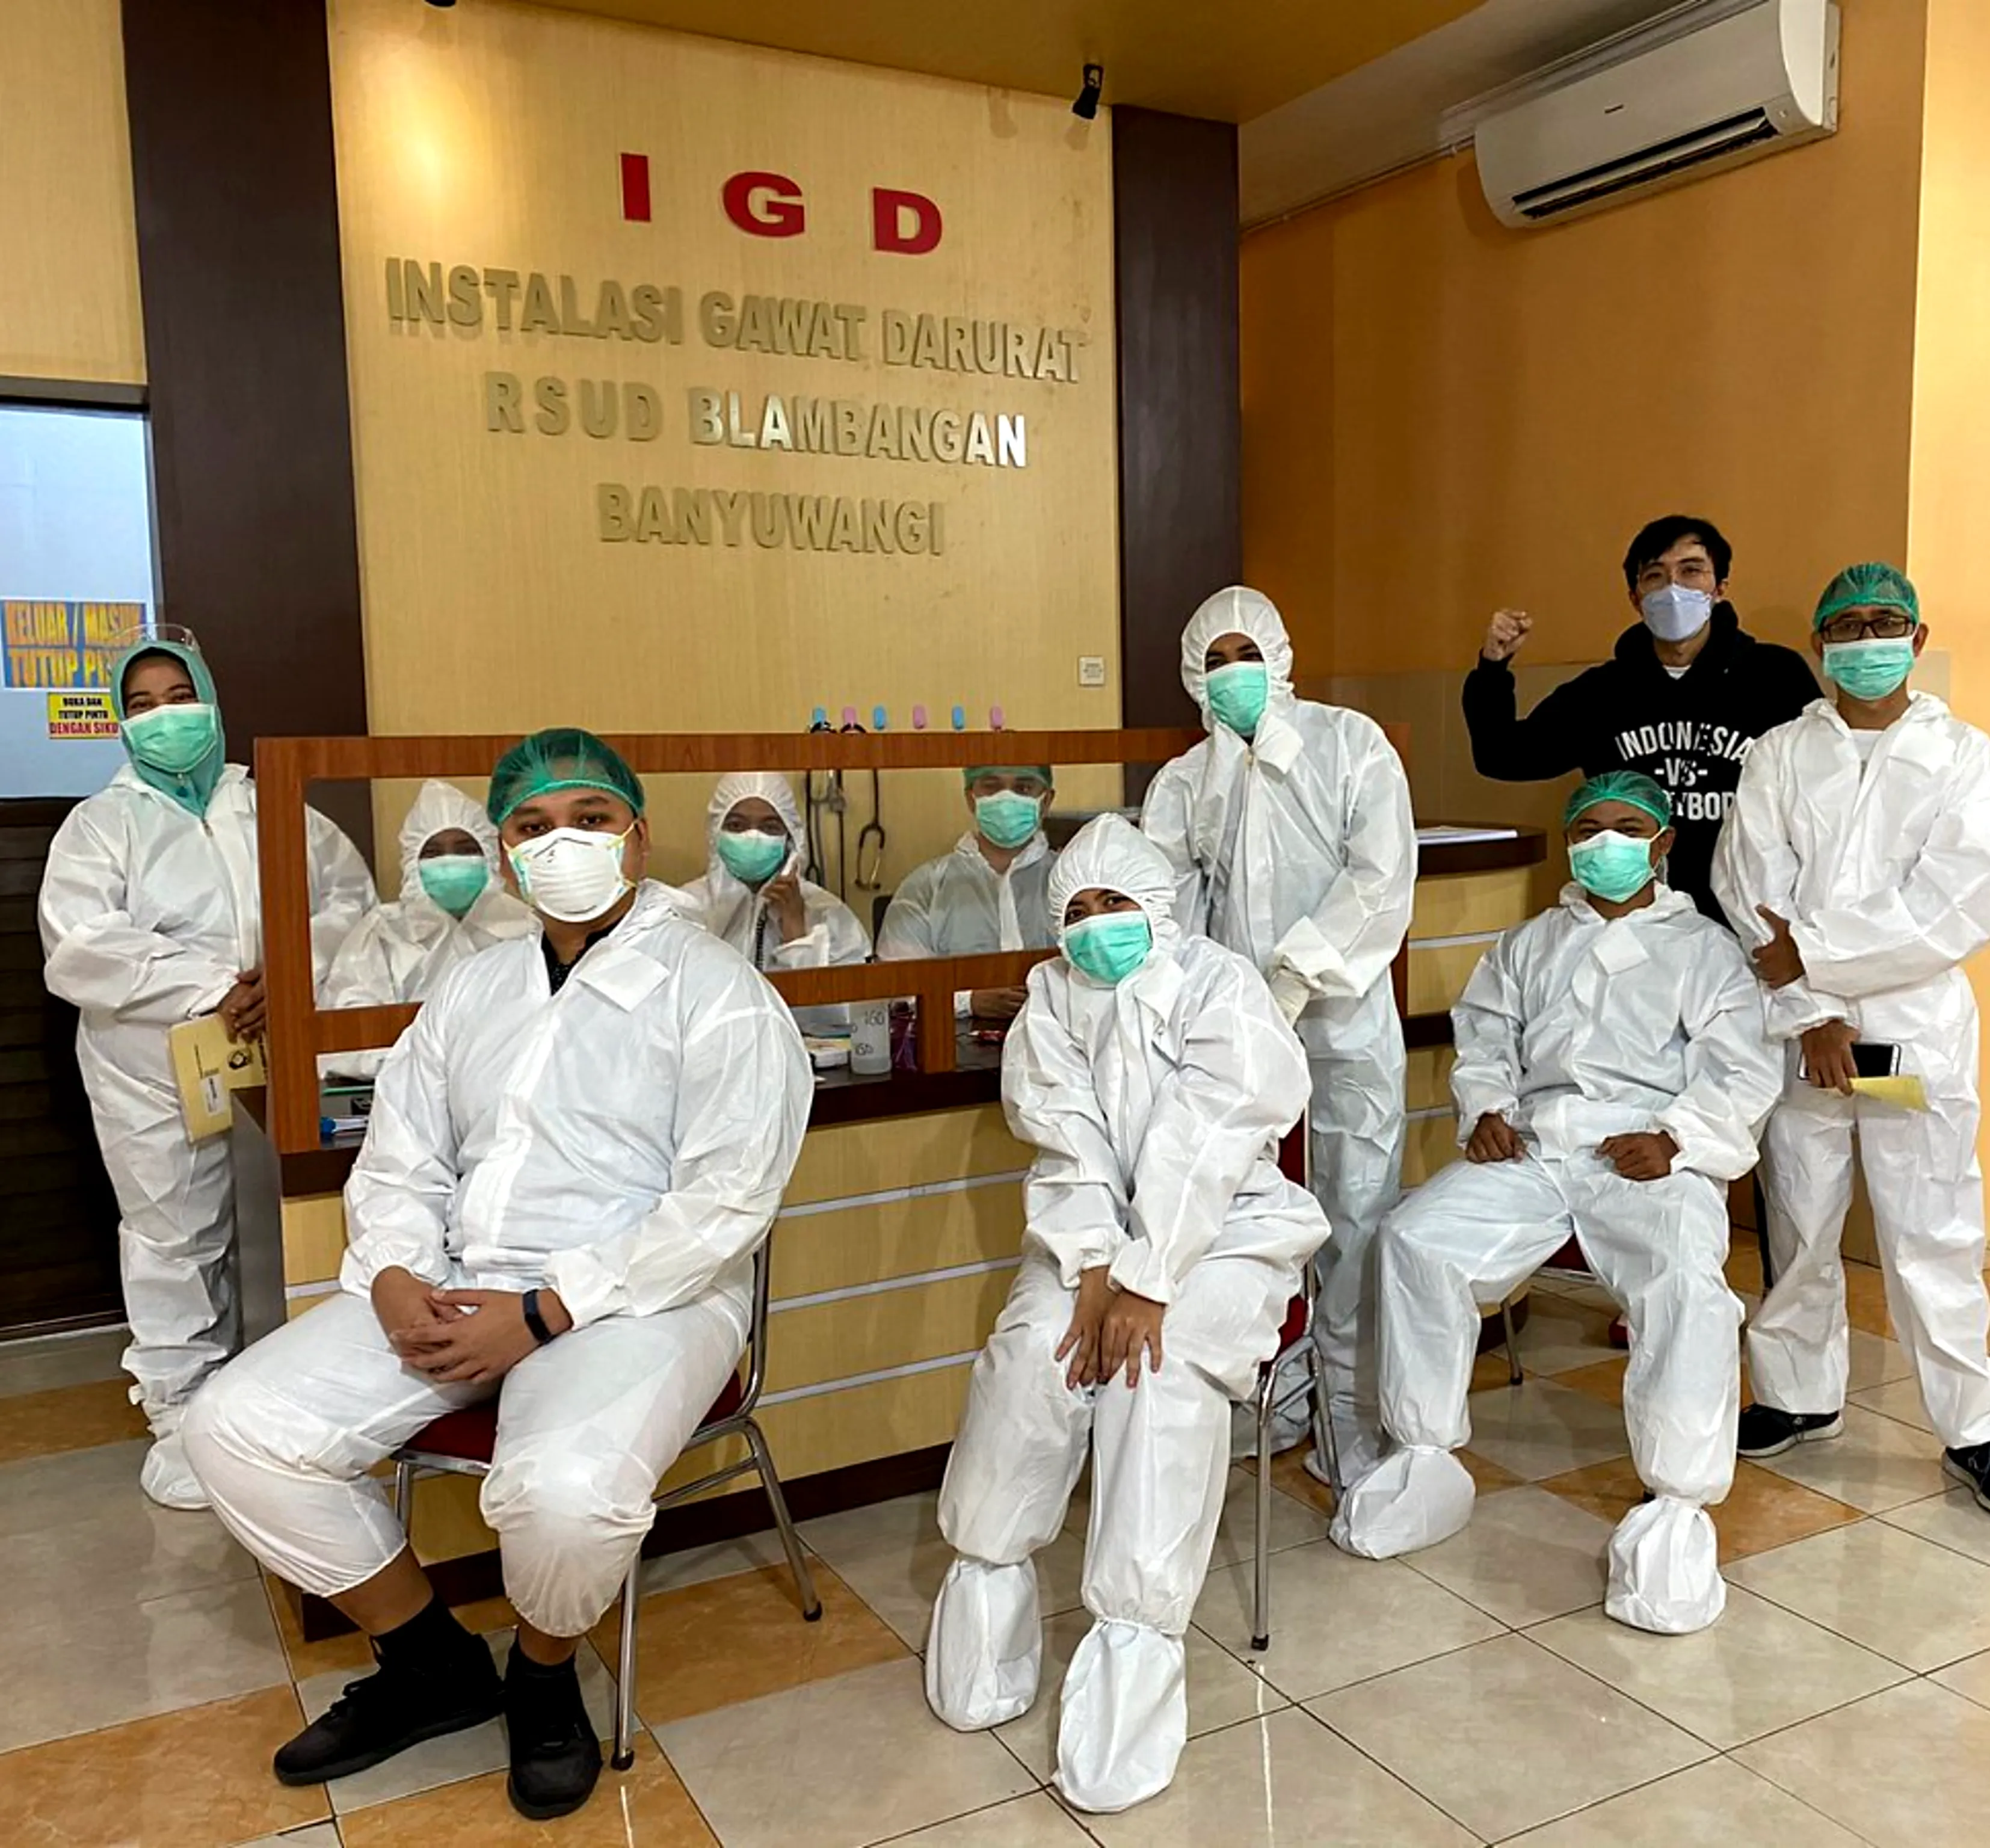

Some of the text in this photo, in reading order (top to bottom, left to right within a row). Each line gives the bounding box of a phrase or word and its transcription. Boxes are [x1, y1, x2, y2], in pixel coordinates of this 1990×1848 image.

[386, 257, 1086, 384] INSTALASI GAWAT DARURAT
[484, 371, 1027, 468] RSUD BLAMBANGAN
[600, 482, 945, 556] BANYUWANGI
[5, 602, 68, 645] KELUAR
[9, 648, 78, 688] TUTUP
[49, 722, 92, 734] DENGAN
[58, 710, 84, 719] TUTUP
[1615, 721, 1754, 765] INDONESIA
